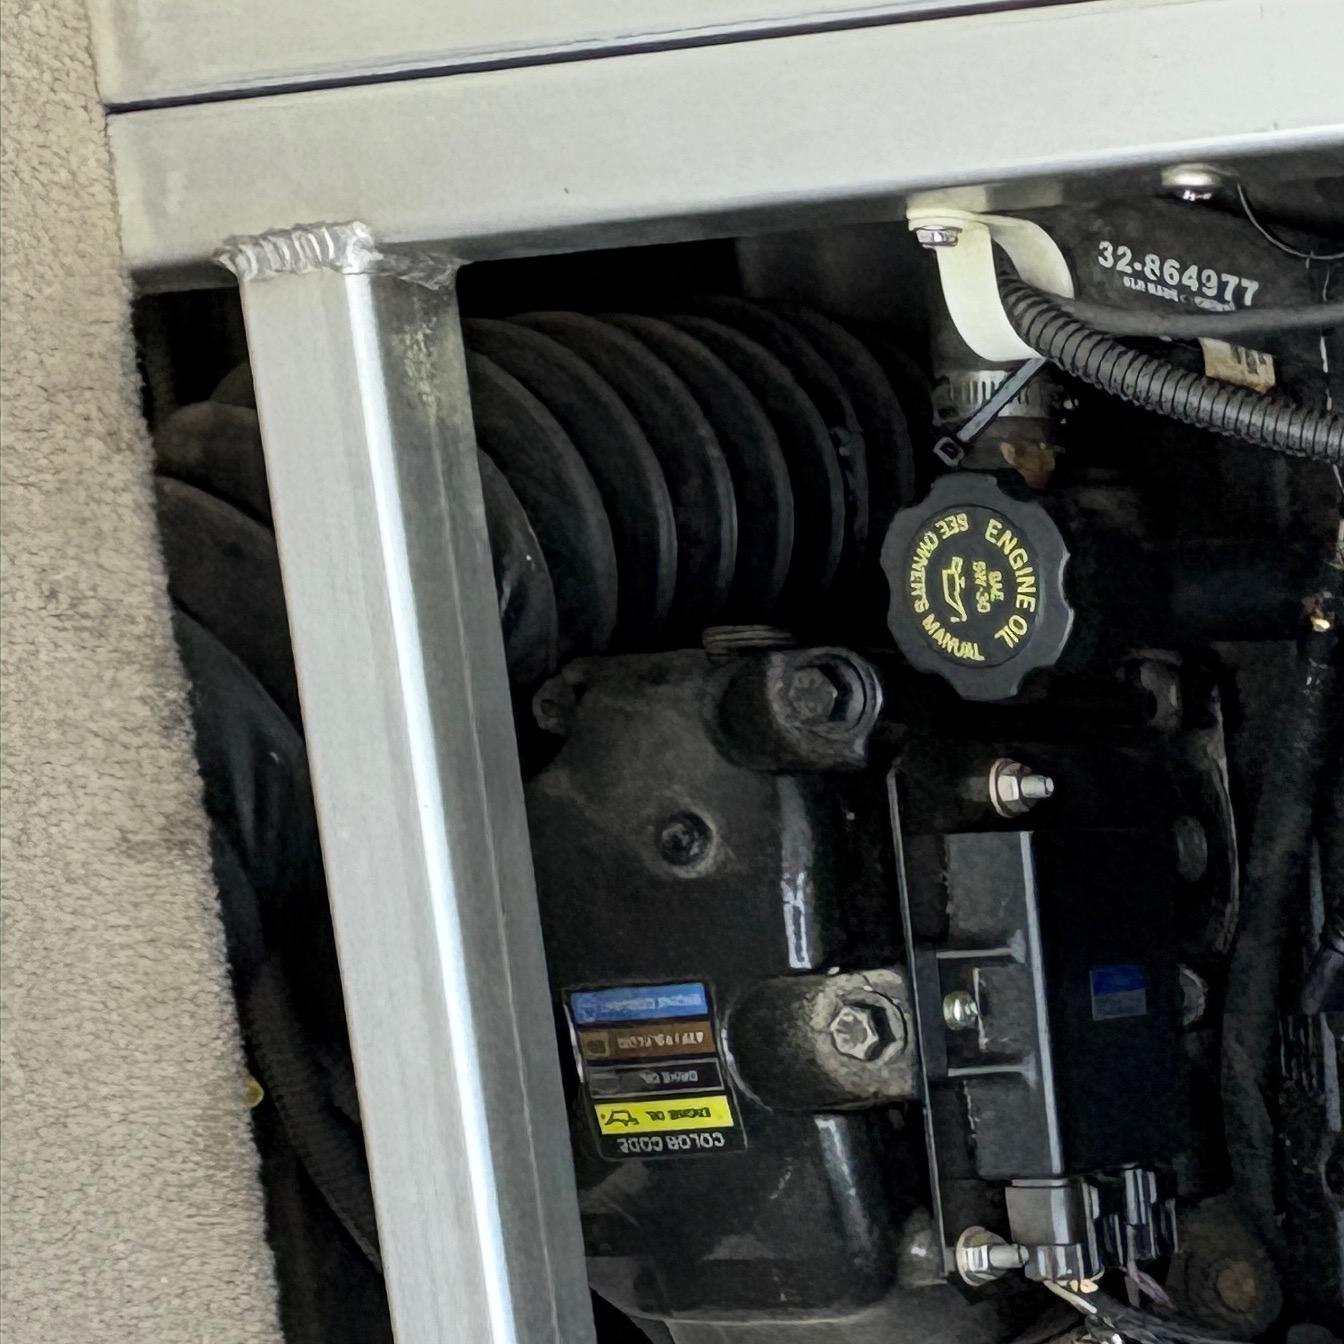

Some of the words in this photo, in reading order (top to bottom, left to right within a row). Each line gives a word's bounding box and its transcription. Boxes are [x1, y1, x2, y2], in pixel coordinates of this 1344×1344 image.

[1098, 241, 1259, 306] 32-864977
[936, 513, 969, 539] SEE
[985, 519, 1037, 612] ENGINE
[922, 614, 985, 661] MANUAL
[994, 614, 1028, 648] OIL
[616, 1135, 663, 1153] CODE
[666, 1132, 725, 1150] COLOR
